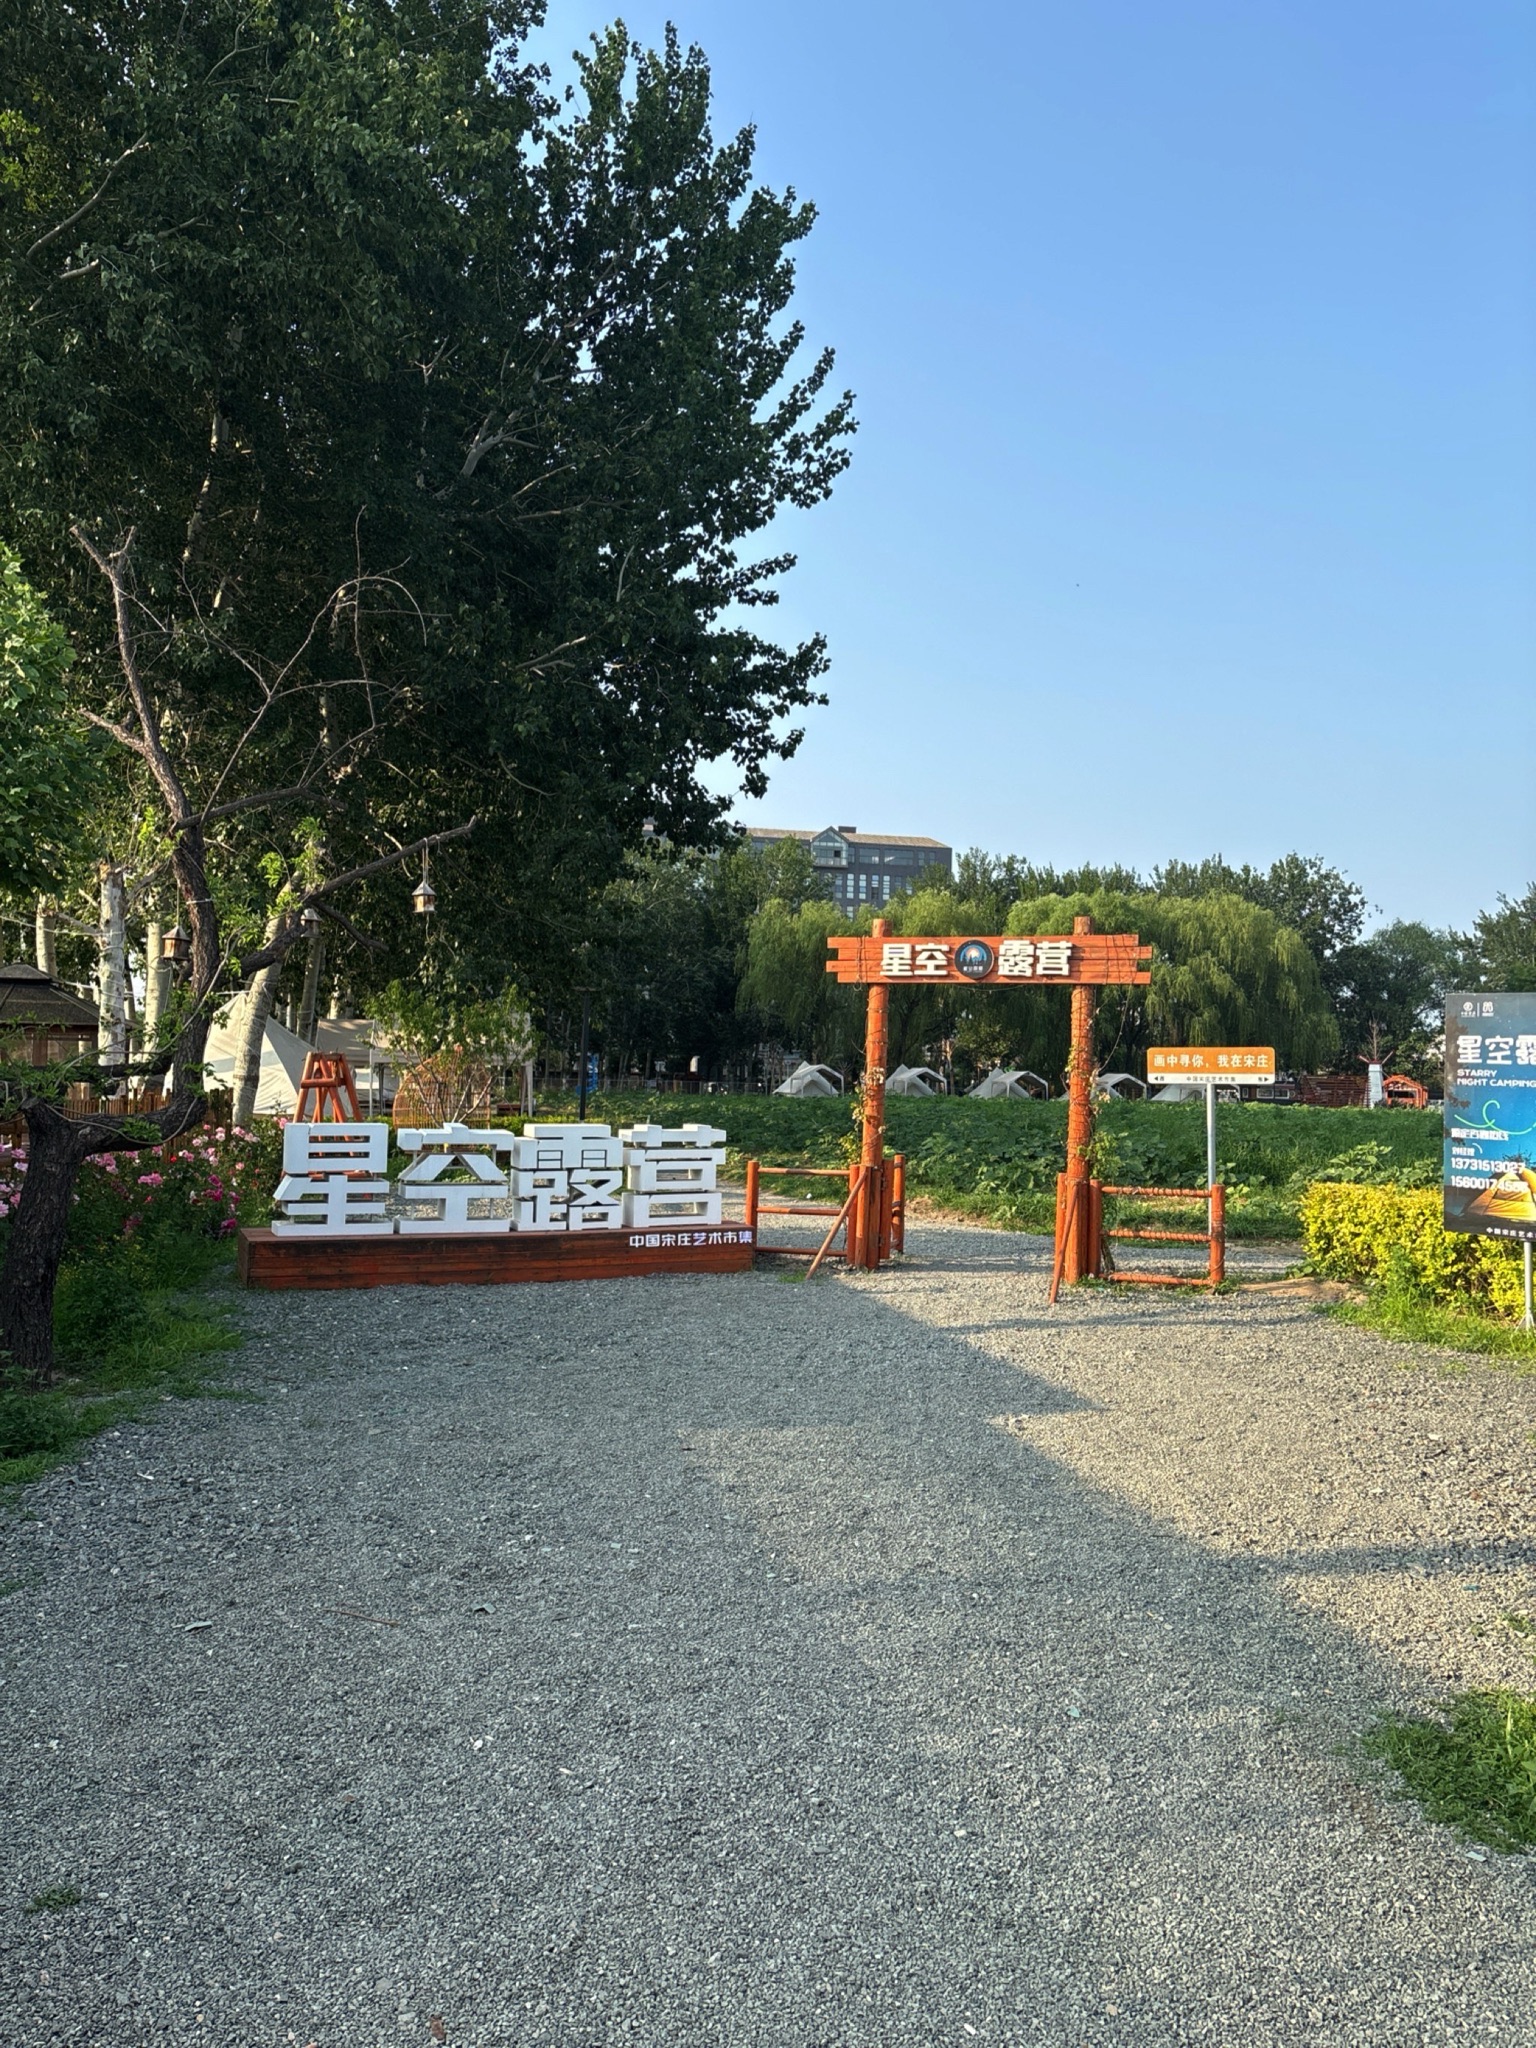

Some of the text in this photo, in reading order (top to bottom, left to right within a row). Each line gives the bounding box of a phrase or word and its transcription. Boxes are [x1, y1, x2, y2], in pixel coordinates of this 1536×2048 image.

[879, 940, 1073, 977] 星空 露营
[1456, 1068, 1497, 1077] STARRY
[1456, 1078, 1536, 1088] NIGHT CAMPING
[271, 1122, 727, 1236] 星空露营
[629, 1230, 753, 1248] 中国宋庄艺术市集
[1486, 1226, 1536, 1239] 中国宋庄艺术
